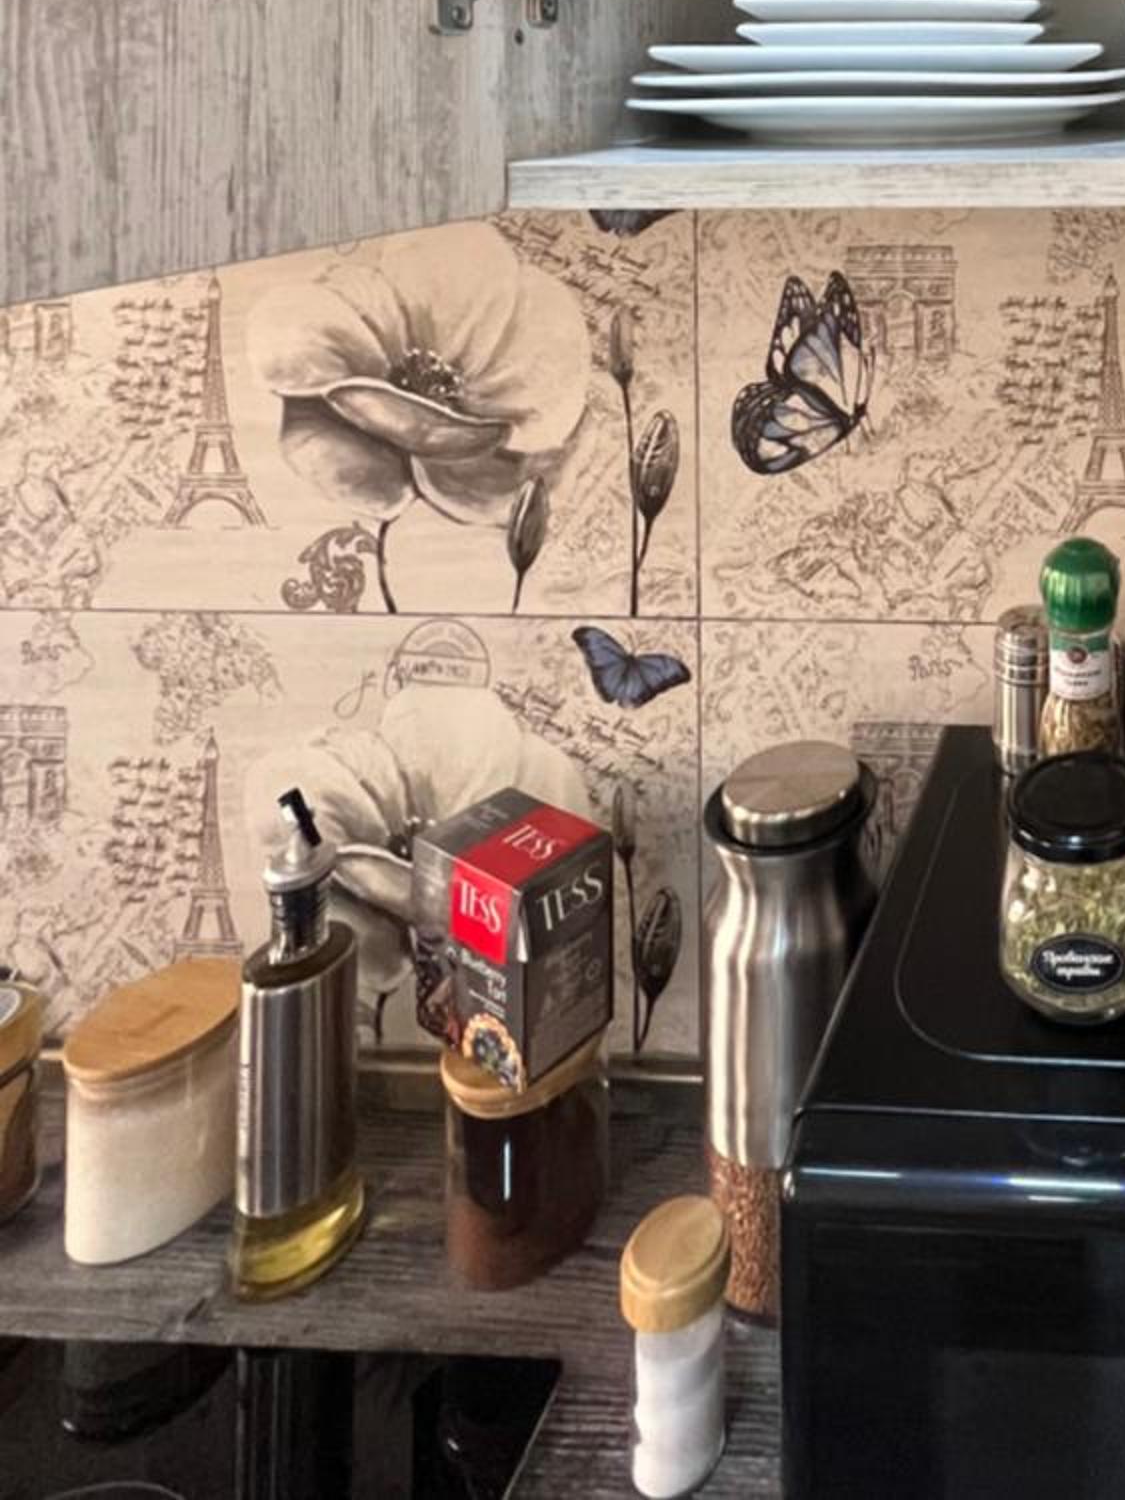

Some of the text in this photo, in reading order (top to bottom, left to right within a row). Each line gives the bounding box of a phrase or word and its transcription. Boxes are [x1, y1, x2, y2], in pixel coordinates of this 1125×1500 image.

[502, 823, 557, 861] TESS
[457, 879, 502, 934] TESS
[536, 861, 604, 931] TESS
